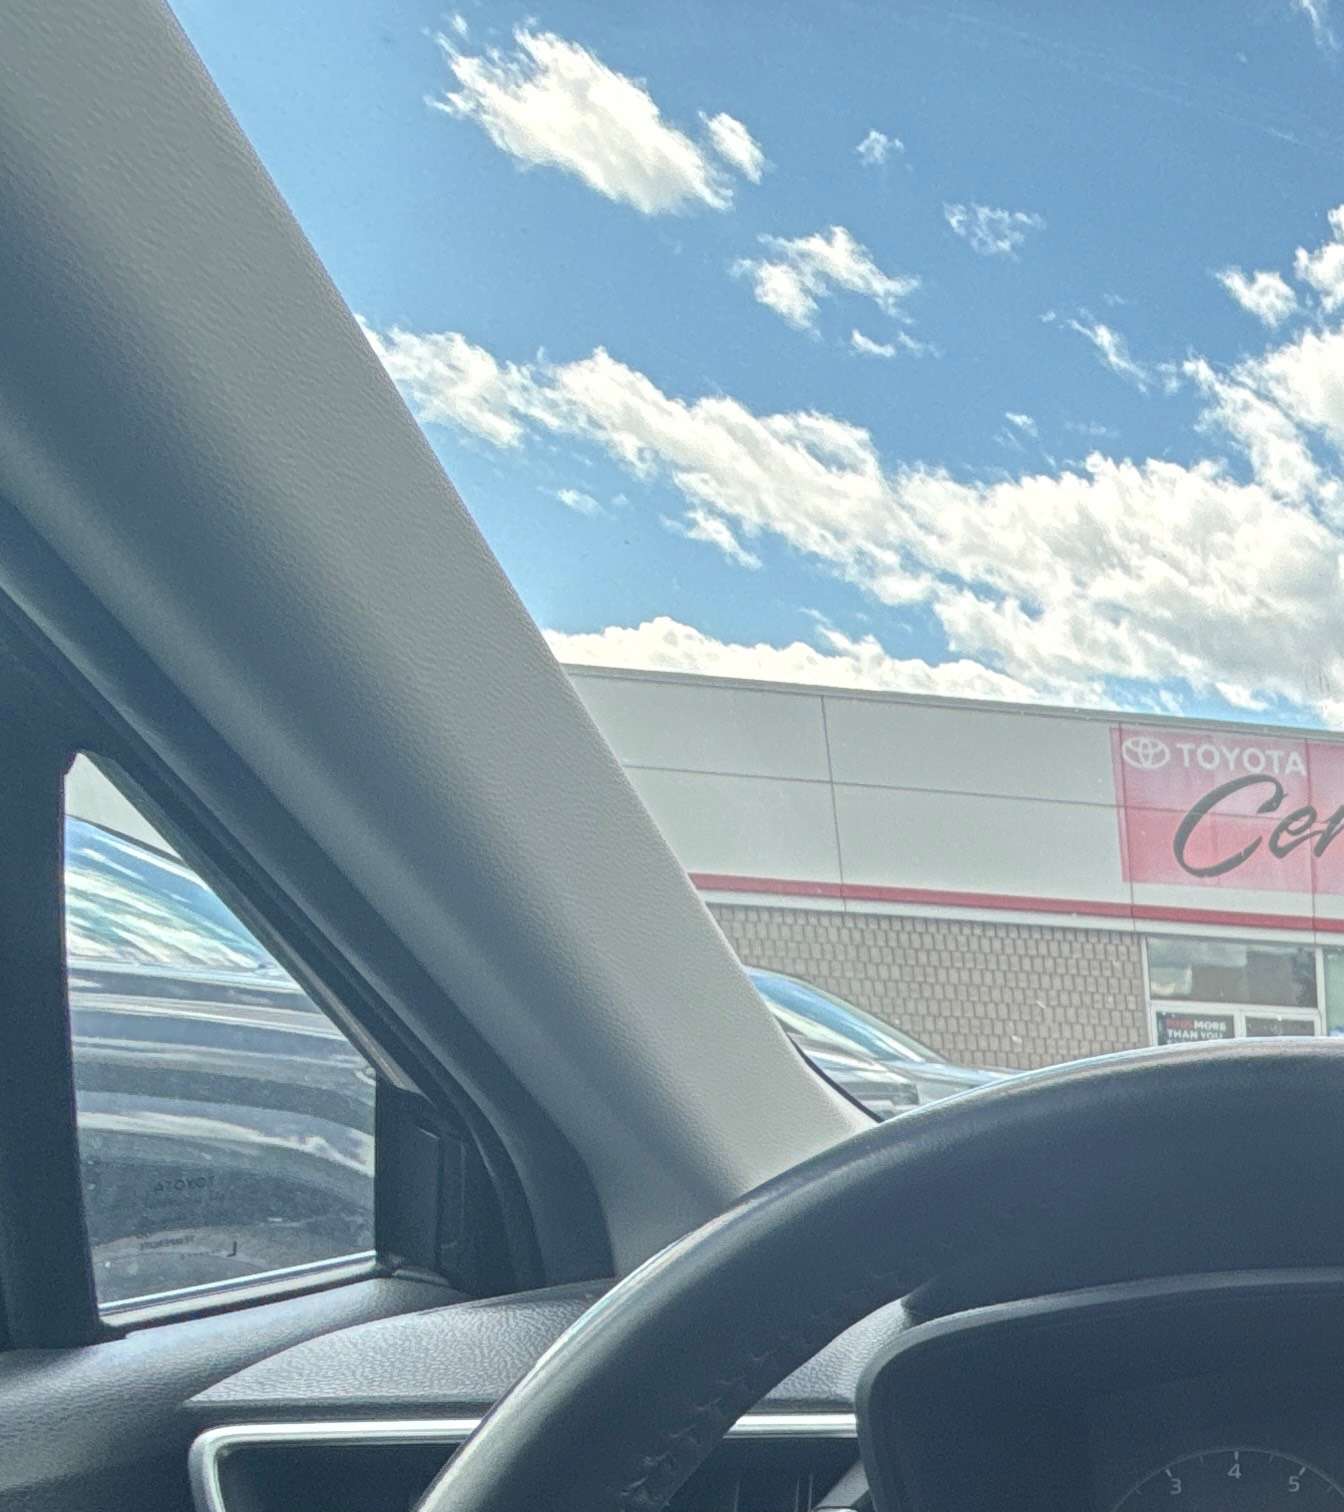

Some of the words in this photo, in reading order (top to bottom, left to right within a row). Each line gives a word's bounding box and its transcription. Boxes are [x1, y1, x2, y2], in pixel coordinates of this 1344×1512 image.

[1177, 743, 1307, 776] TOYOTA
[1227, 1462, 1243, 1480] 4
[1169, 1476, 1183, 1494] 3
[1287, 1475, 1301, 1493] 5
